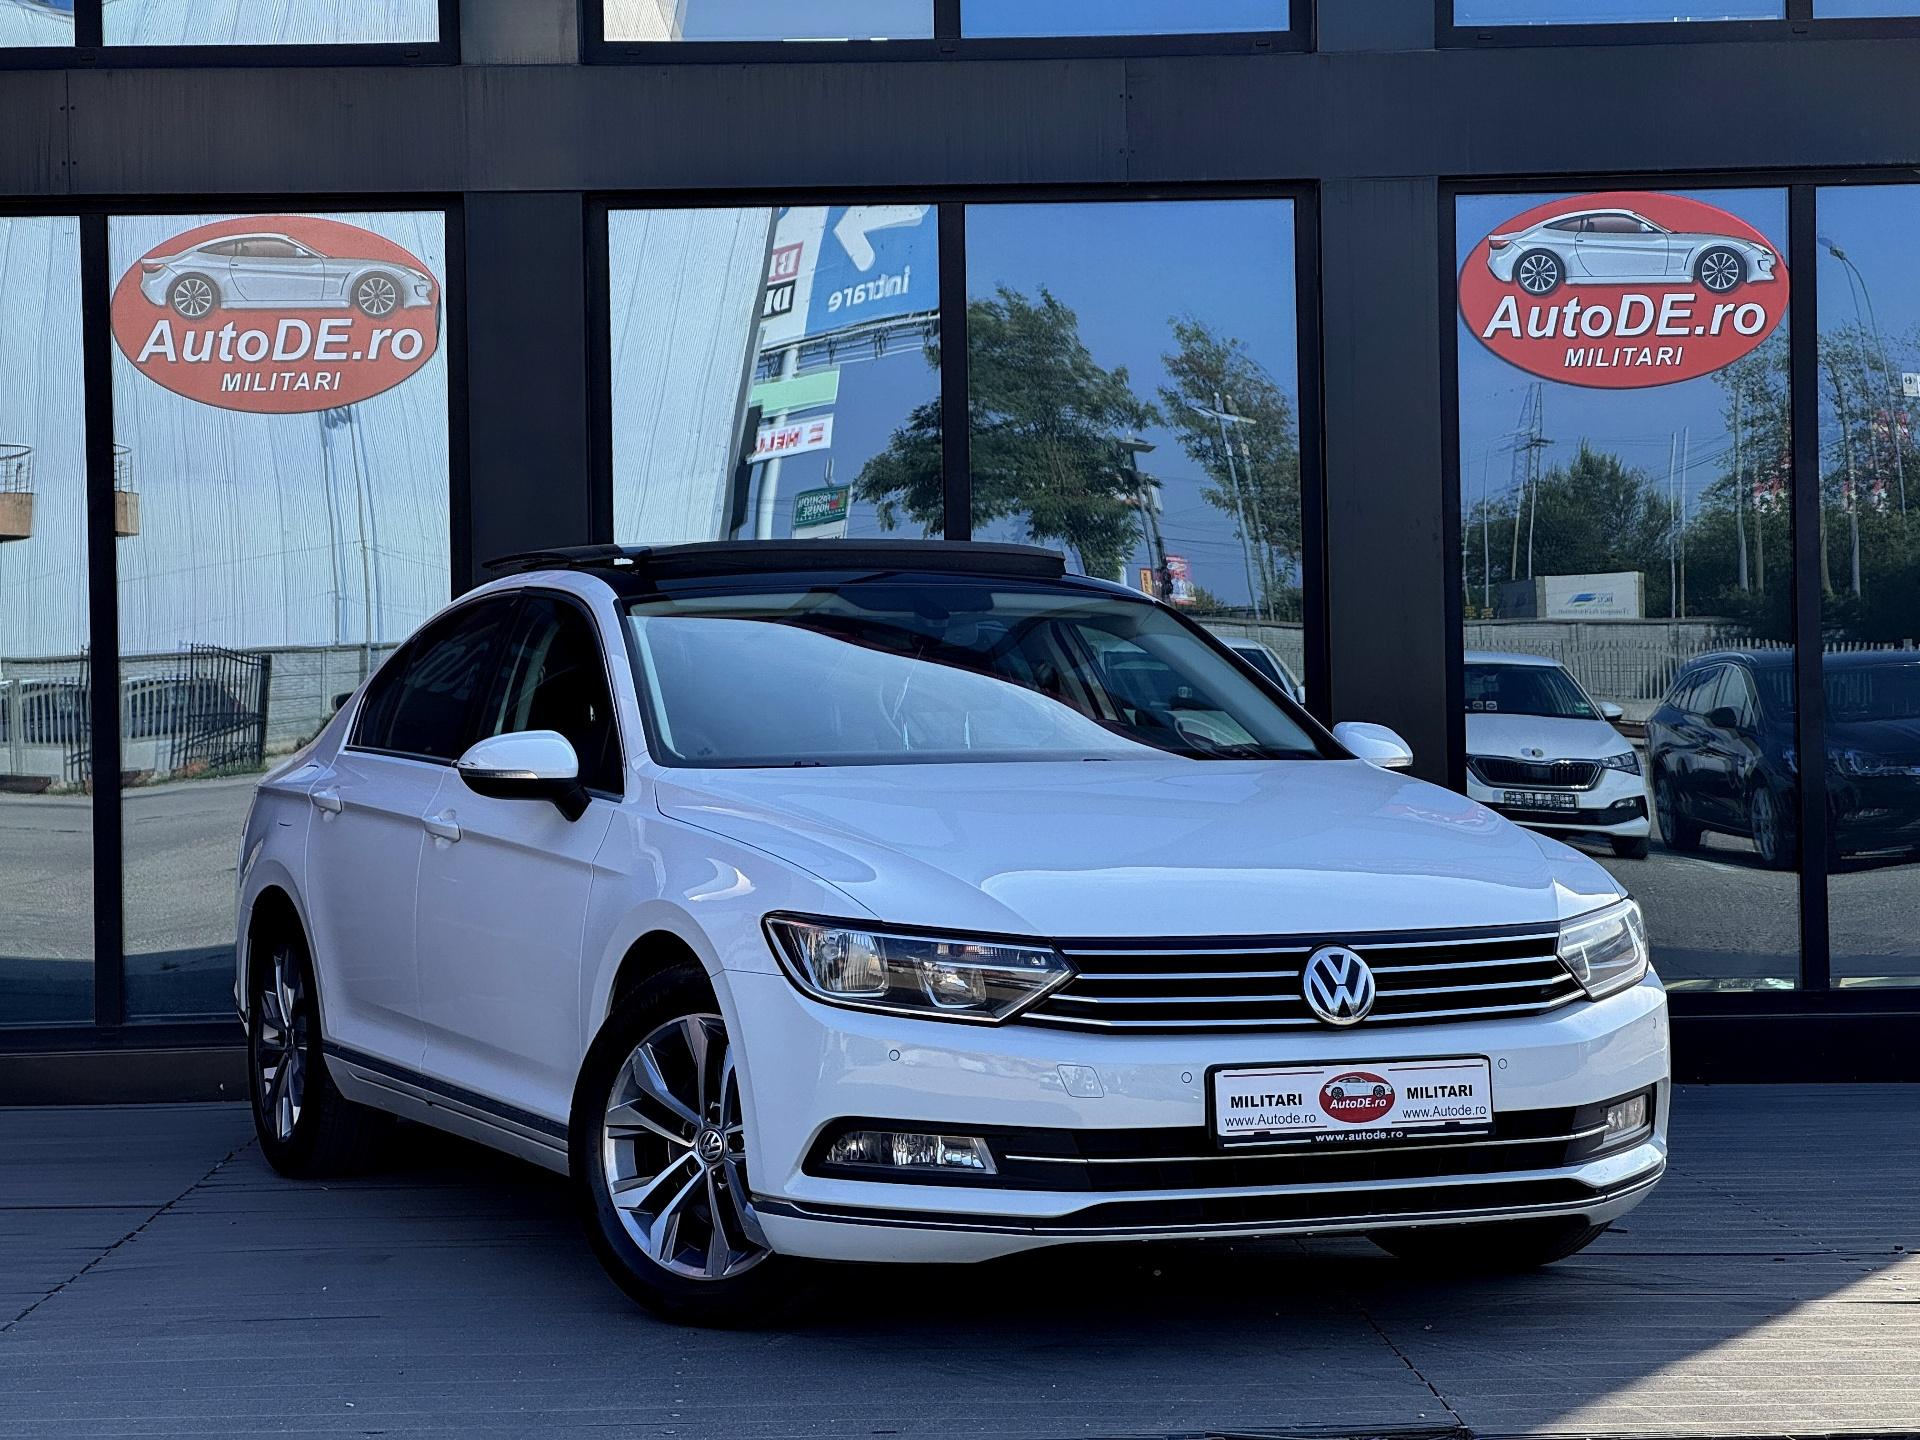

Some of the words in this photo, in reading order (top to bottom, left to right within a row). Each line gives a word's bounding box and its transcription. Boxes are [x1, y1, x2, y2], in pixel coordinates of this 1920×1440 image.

[1483, 293, 1766, 339] AutoDE.ro
[137, 318, 424, 363] AutoDE.ro
[1564, 346, 1684, 367] MILITARI
[221, 371, 342, 392] MILITARI
[1407, 1084, 1474, 1100] MILITARI
[1231, 1093, 1303, 1109] MILITARI
[1329, 1097, 1387, 1110] AutoDE.ro
[1225, 1112, 1317, 1127] www.Autode.ro
[1402, 1104, 1487, 1119] www.Autode.ro
[1315, 1129, 1404, 1143] www.autode.ro
